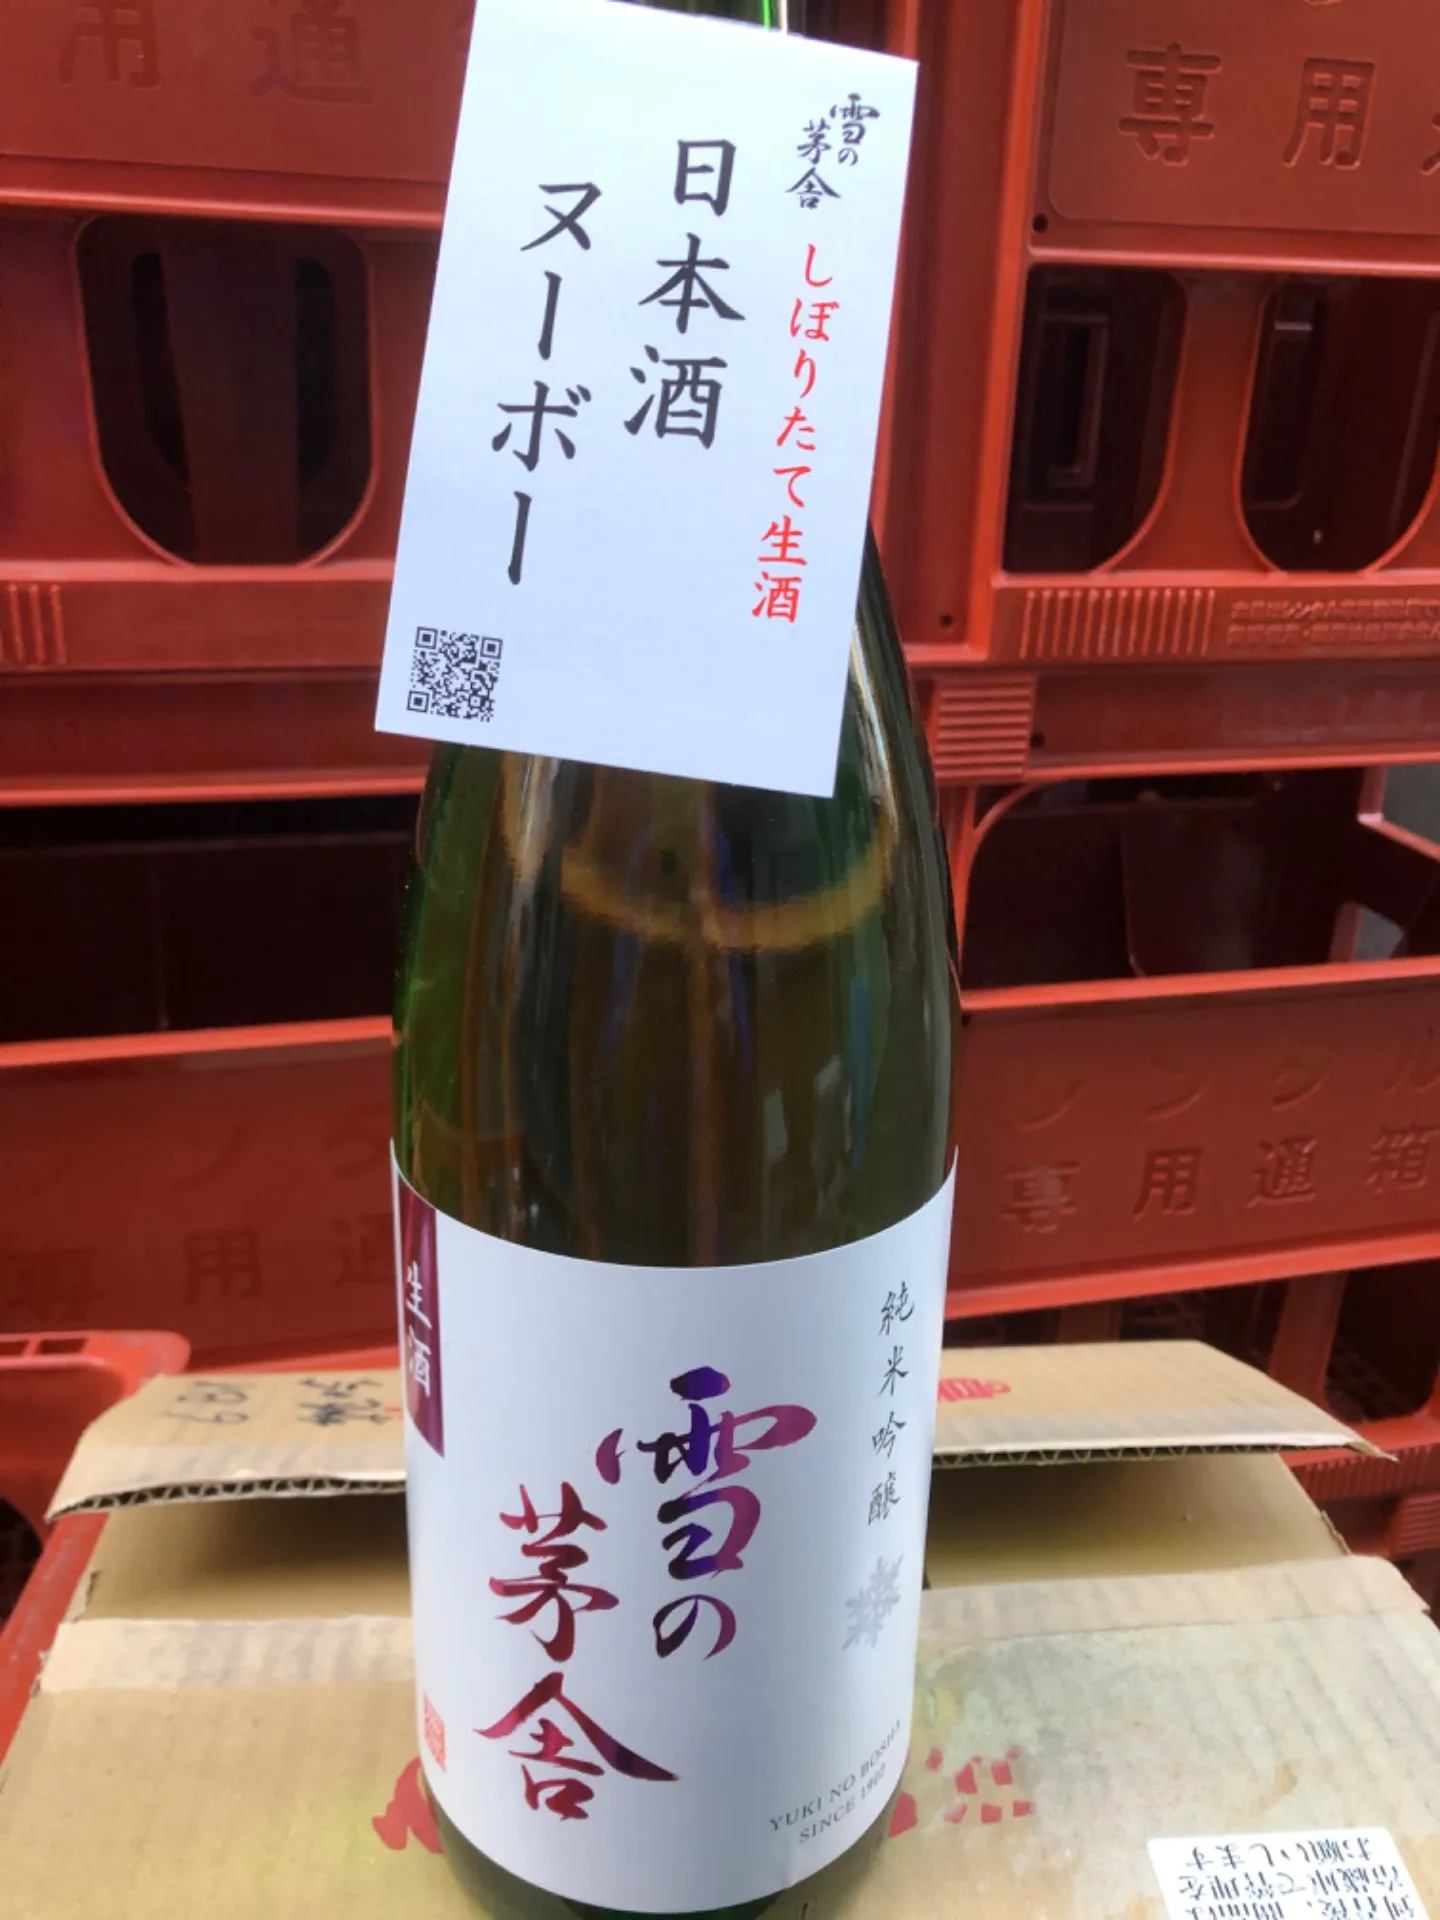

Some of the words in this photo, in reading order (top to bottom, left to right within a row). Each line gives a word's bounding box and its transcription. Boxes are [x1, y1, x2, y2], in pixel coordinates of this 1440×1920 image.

[785, 117, 842, 209] 茅舎
[829, 93, 881, 166] 雪の
[1118, 42, 1440, 176] 専用
[492, 181, 605, 587] ヌーボー
[624, 137, 744, 449] 日本酒
[751, 243, 839, 625] しぼりたて生酒
[406, 1260, 432, 1397] 生酒
[867, 1280, 915, 1528] 純米吟醸
[595, 1365, 818, 1662] 雪の
[472, 1480, 680, 1822] 茅舎
[769, 1797, 822, 1832] YUKI
[829, 1774, 856, 1803] NO
[799, 1796, 856, 1844] SINCE
